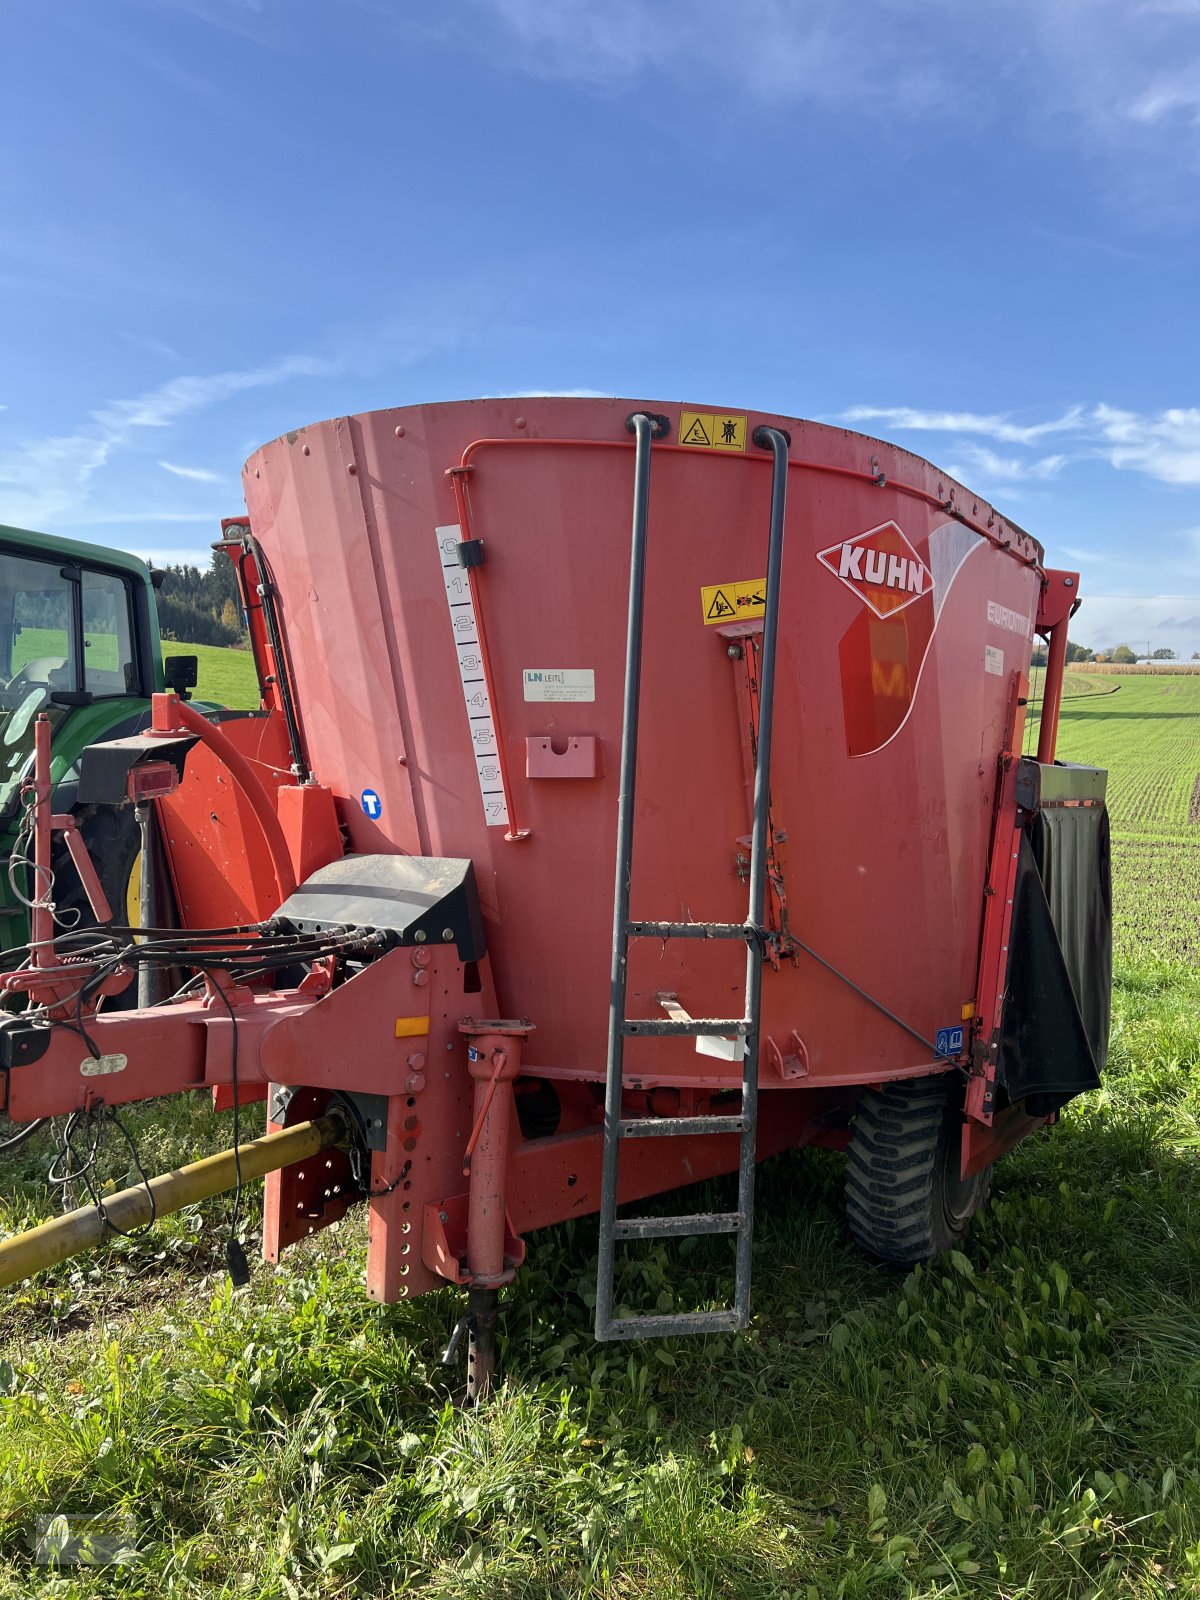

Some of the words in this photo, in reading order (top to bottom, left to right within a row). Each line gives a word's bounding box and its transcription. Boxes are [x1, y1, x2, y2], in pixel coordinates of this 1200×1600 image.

[443, 538, 457, 554] 0
[839, 543, 924, 595] KUHN
[452, 577, 462, 593] 1
[456, 616, 473, 632] 2
[463, 655, 479, 670] 3
[471, 692, 485, 707] 4
[475, 729, 491, 744] 5
[482, 766, 497, 780] 6
[363, 795, 377, 814] T
[488, 802, 503, 816] 7
